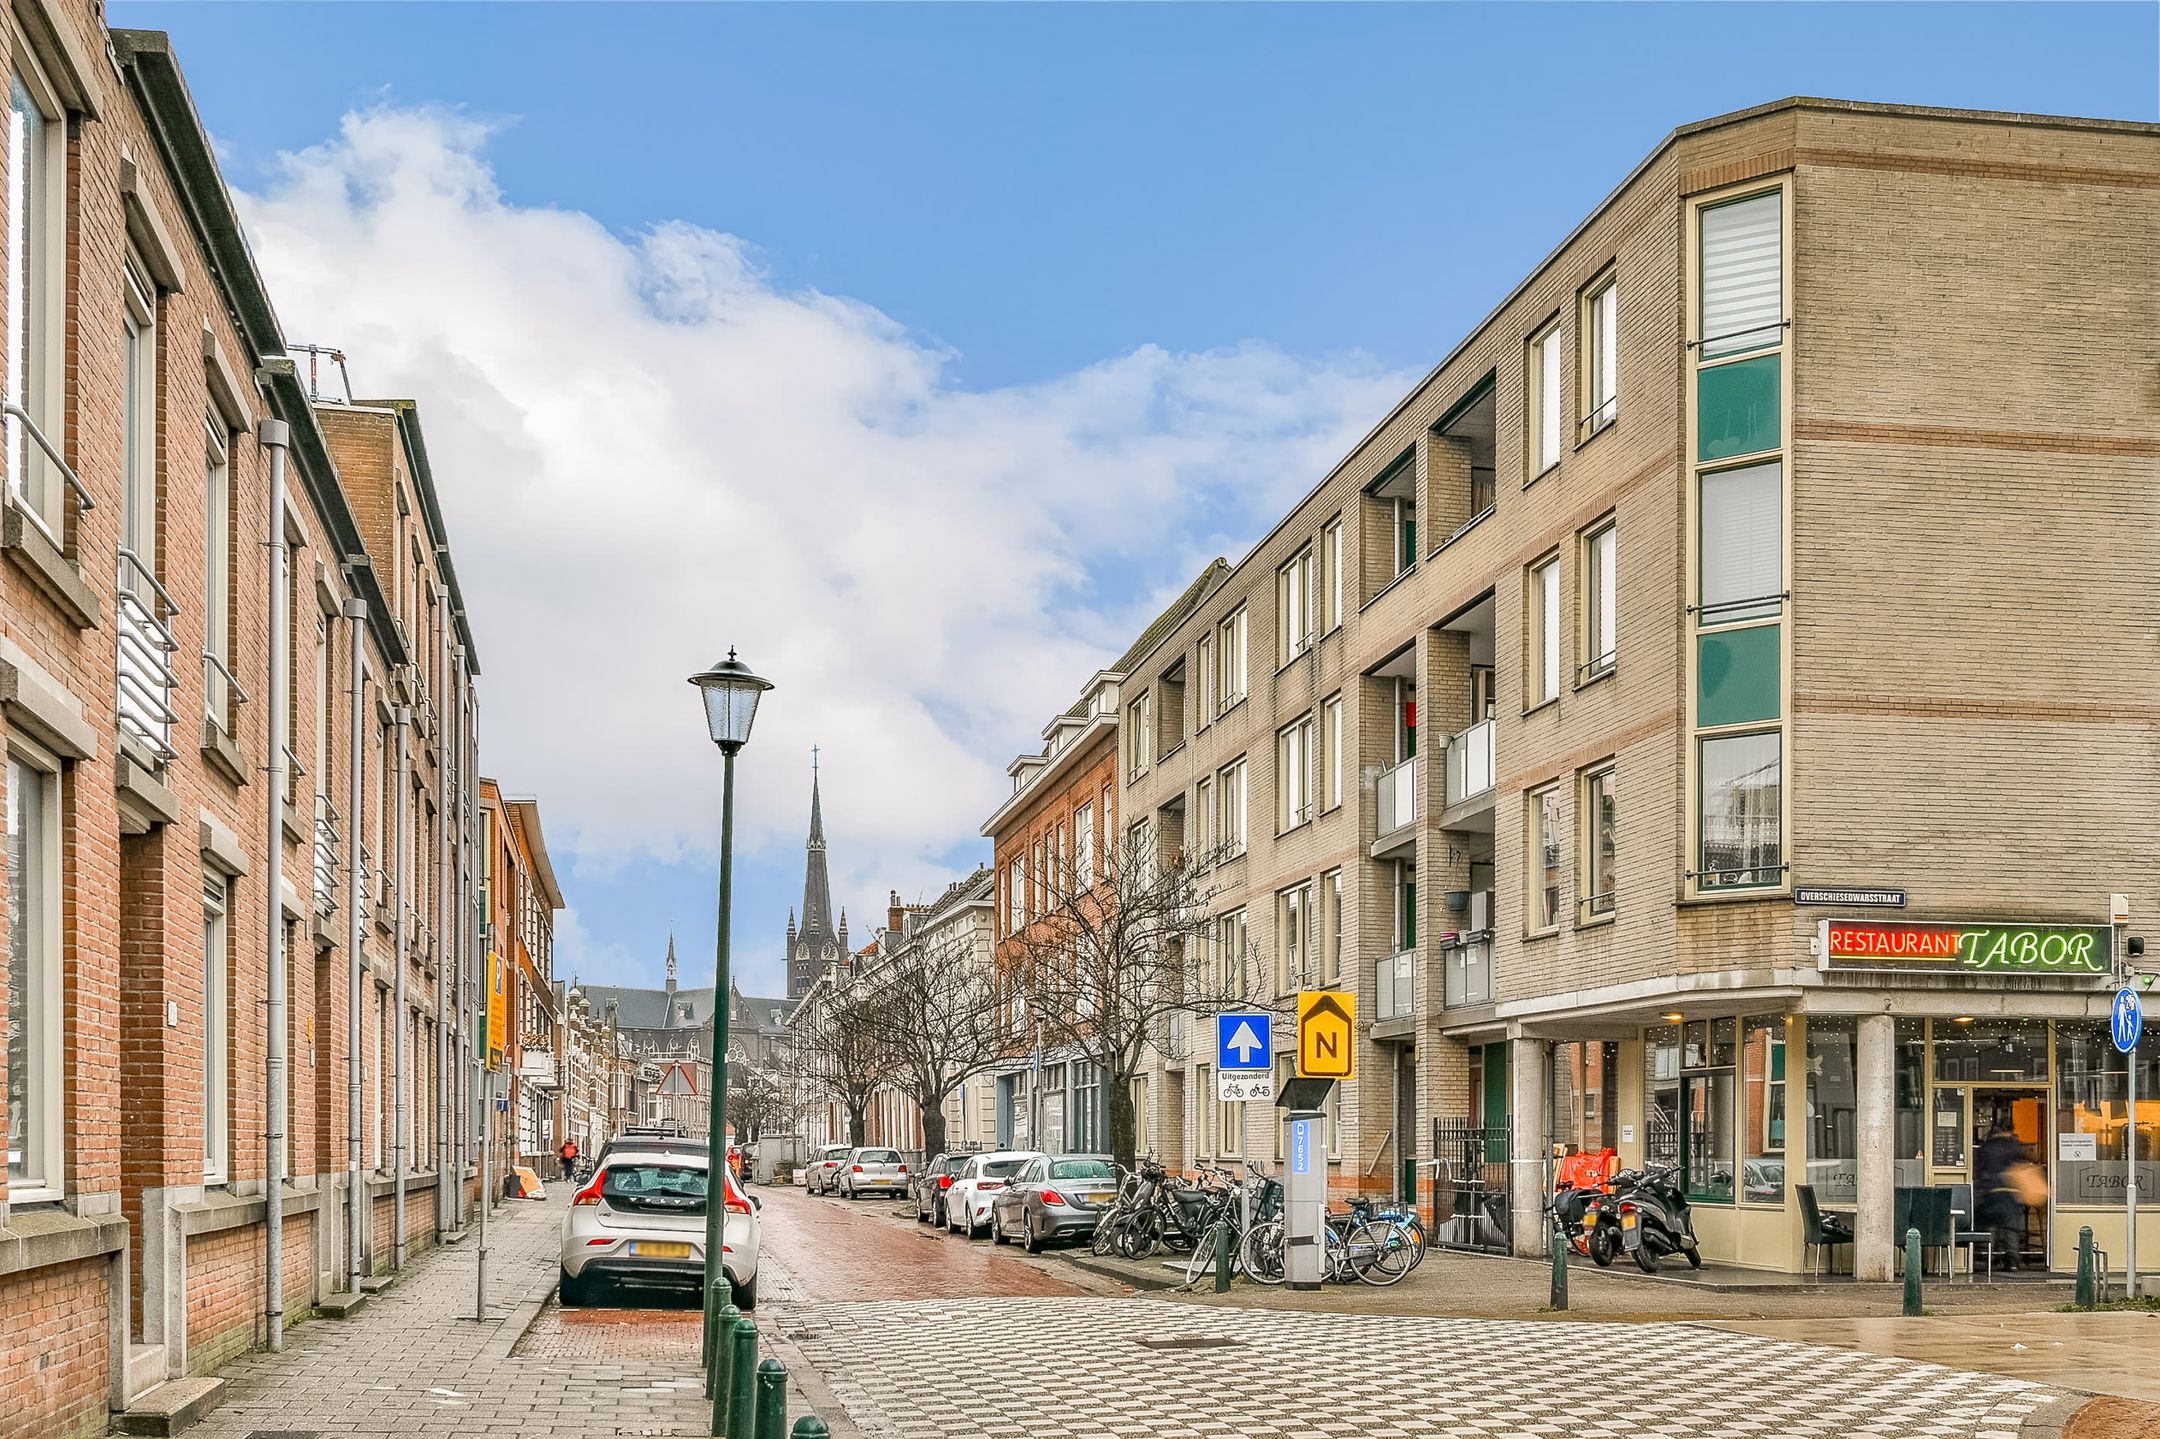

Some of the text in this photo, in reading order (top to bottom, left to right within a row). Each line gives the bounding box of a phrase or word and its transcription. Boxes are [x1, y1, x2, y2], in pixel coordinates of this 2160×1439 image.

[1830, 929, 2103, 972] RESTAURANT TABOR
[1316, 1032, 1337, 1059] N
[1222, 1072, 1270, 1081] Uitgezonderd
